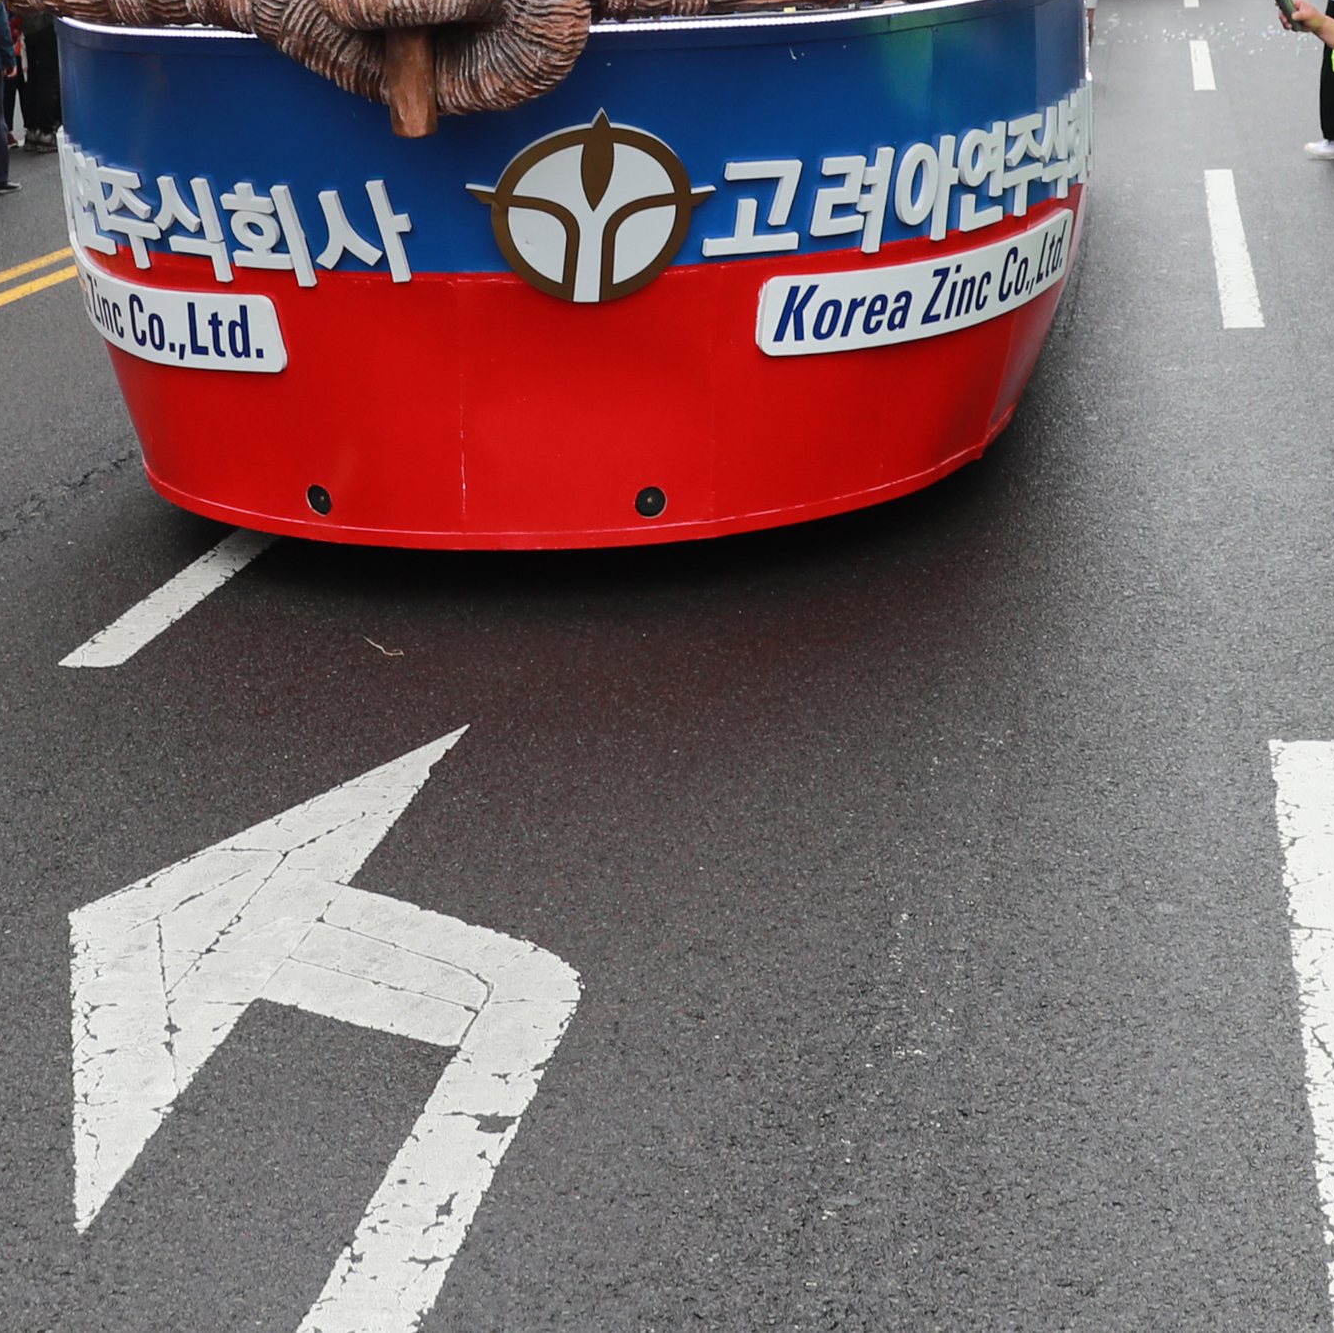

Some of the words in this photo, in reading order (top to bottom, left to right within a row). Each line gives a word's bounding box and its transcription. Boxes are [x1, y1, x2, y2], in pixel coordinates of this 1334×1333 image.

[57, 126, 412, 287] 연주식회사
[701, 80, 1093, 258] 고려아연주식회
[128, 293, 265, 361] Co.,Ltd.
[772, 283, 913, 343] Korea
[920, 263, 992, 327] Zinc
[997, 219, 1068, 303] Co.,Ltd.
